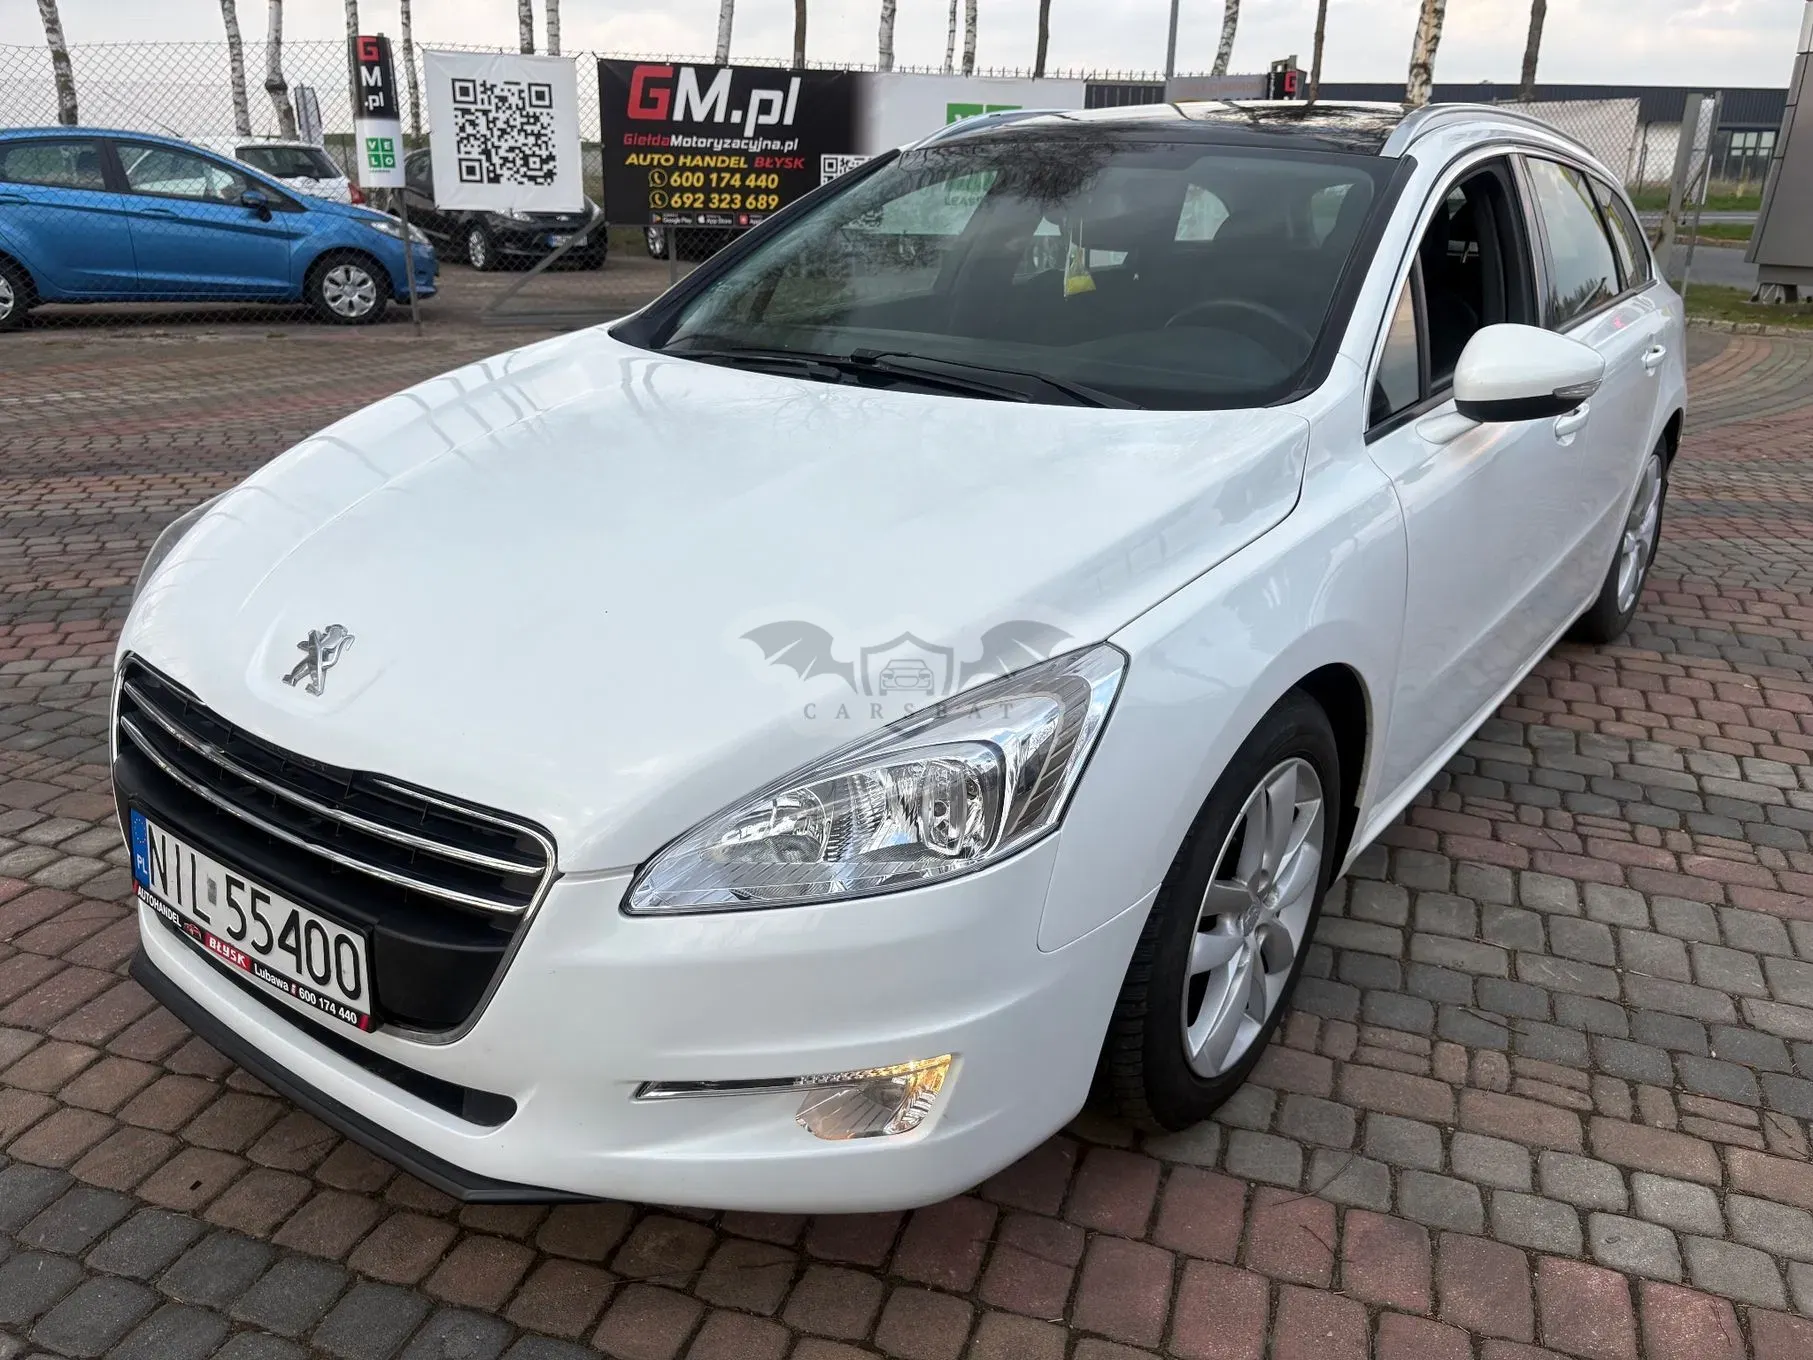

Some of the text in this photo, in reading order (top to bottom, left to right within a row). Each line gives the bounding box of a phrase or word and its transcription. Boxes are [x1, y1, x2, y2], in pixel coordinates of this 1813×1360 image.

[357, 35, 380, 61] G
[364, 92, 385, 111] .pl
[626, 64, 802, 138] GM.pl
[623, 132, 799, 153] GiełdaMotoryzacyjna.pl
[625, 153, 805, 169] AUTO HANDEL BŁYSK
[670, 171, 779, 189] 600 174 440
[670, 193, 779, 210] 692 323 689
[137, 854, 148, 875] PL
[137, 885, 182, 928] AUTOHANDEL
[148, 823, 362, 1001] NIL 55400
[254, 963, 358, 1025] Lubawa 600 174 440
